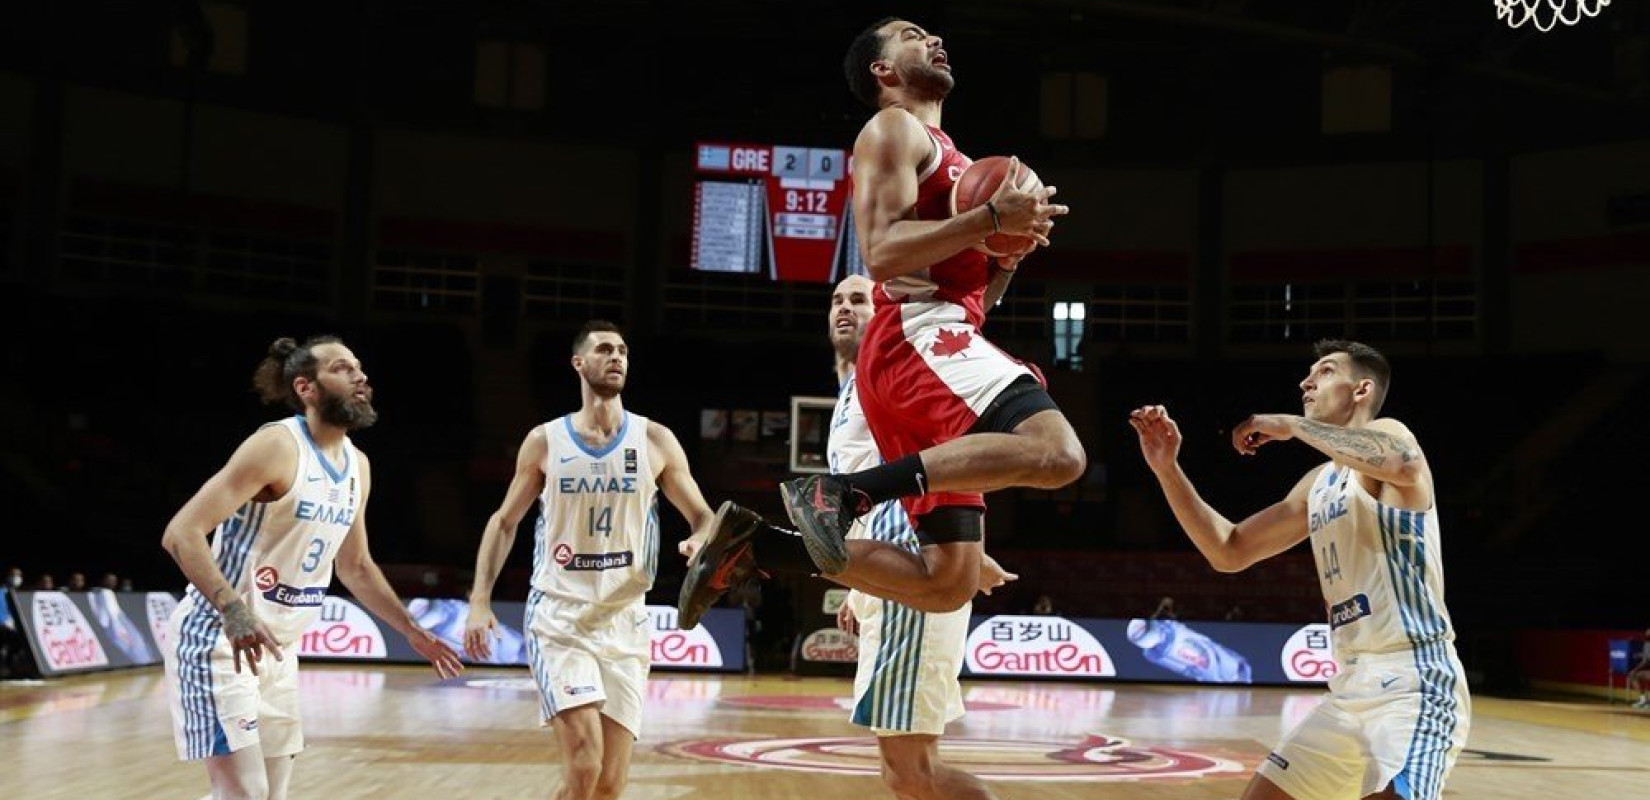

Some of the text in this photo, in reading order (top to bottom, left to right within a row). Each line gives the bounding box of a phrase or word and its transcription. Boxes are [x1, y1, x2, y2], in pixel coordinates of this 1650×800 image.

[732, 148, 770, 172] GRE
[785, 153, 797, 171] 2
[821, 155, 832, 173] 0
[785, 190, 828, 213] 9:12
[559, 477, 638, 494] ΕΛΛΑΣ
[588, 506, 613, 537] 14
[301, 538, 331, 573] 3
[1322, 541, 1342, 585] 44
[991, 621, 1072, 642] 百岁山
